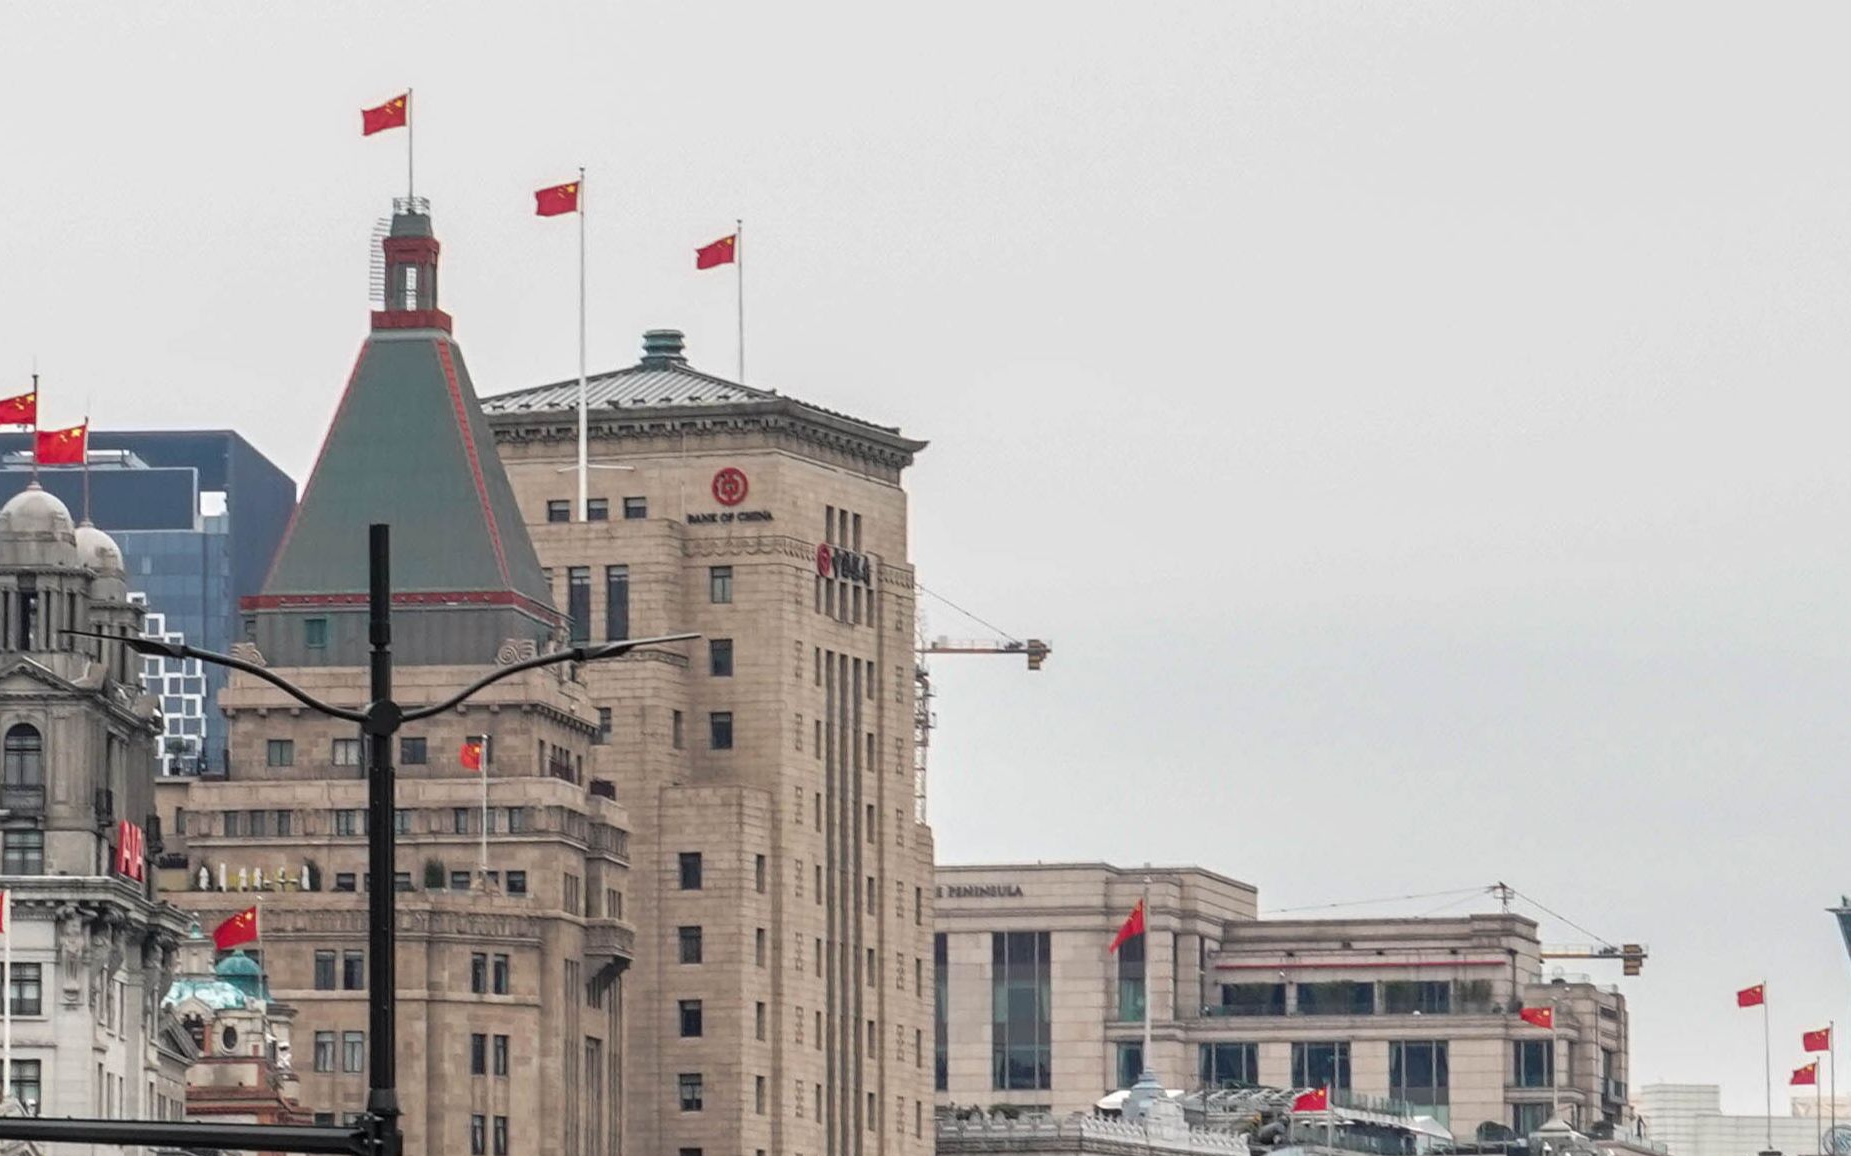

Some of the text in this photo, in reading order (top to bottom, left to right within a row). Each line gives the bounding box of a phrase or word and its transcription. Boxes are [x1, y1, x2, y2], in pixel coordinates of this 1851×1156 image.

[687, 509, 774, 525] BANK OF CHINA
[948, 885, 1024, 898] PENINSULA
